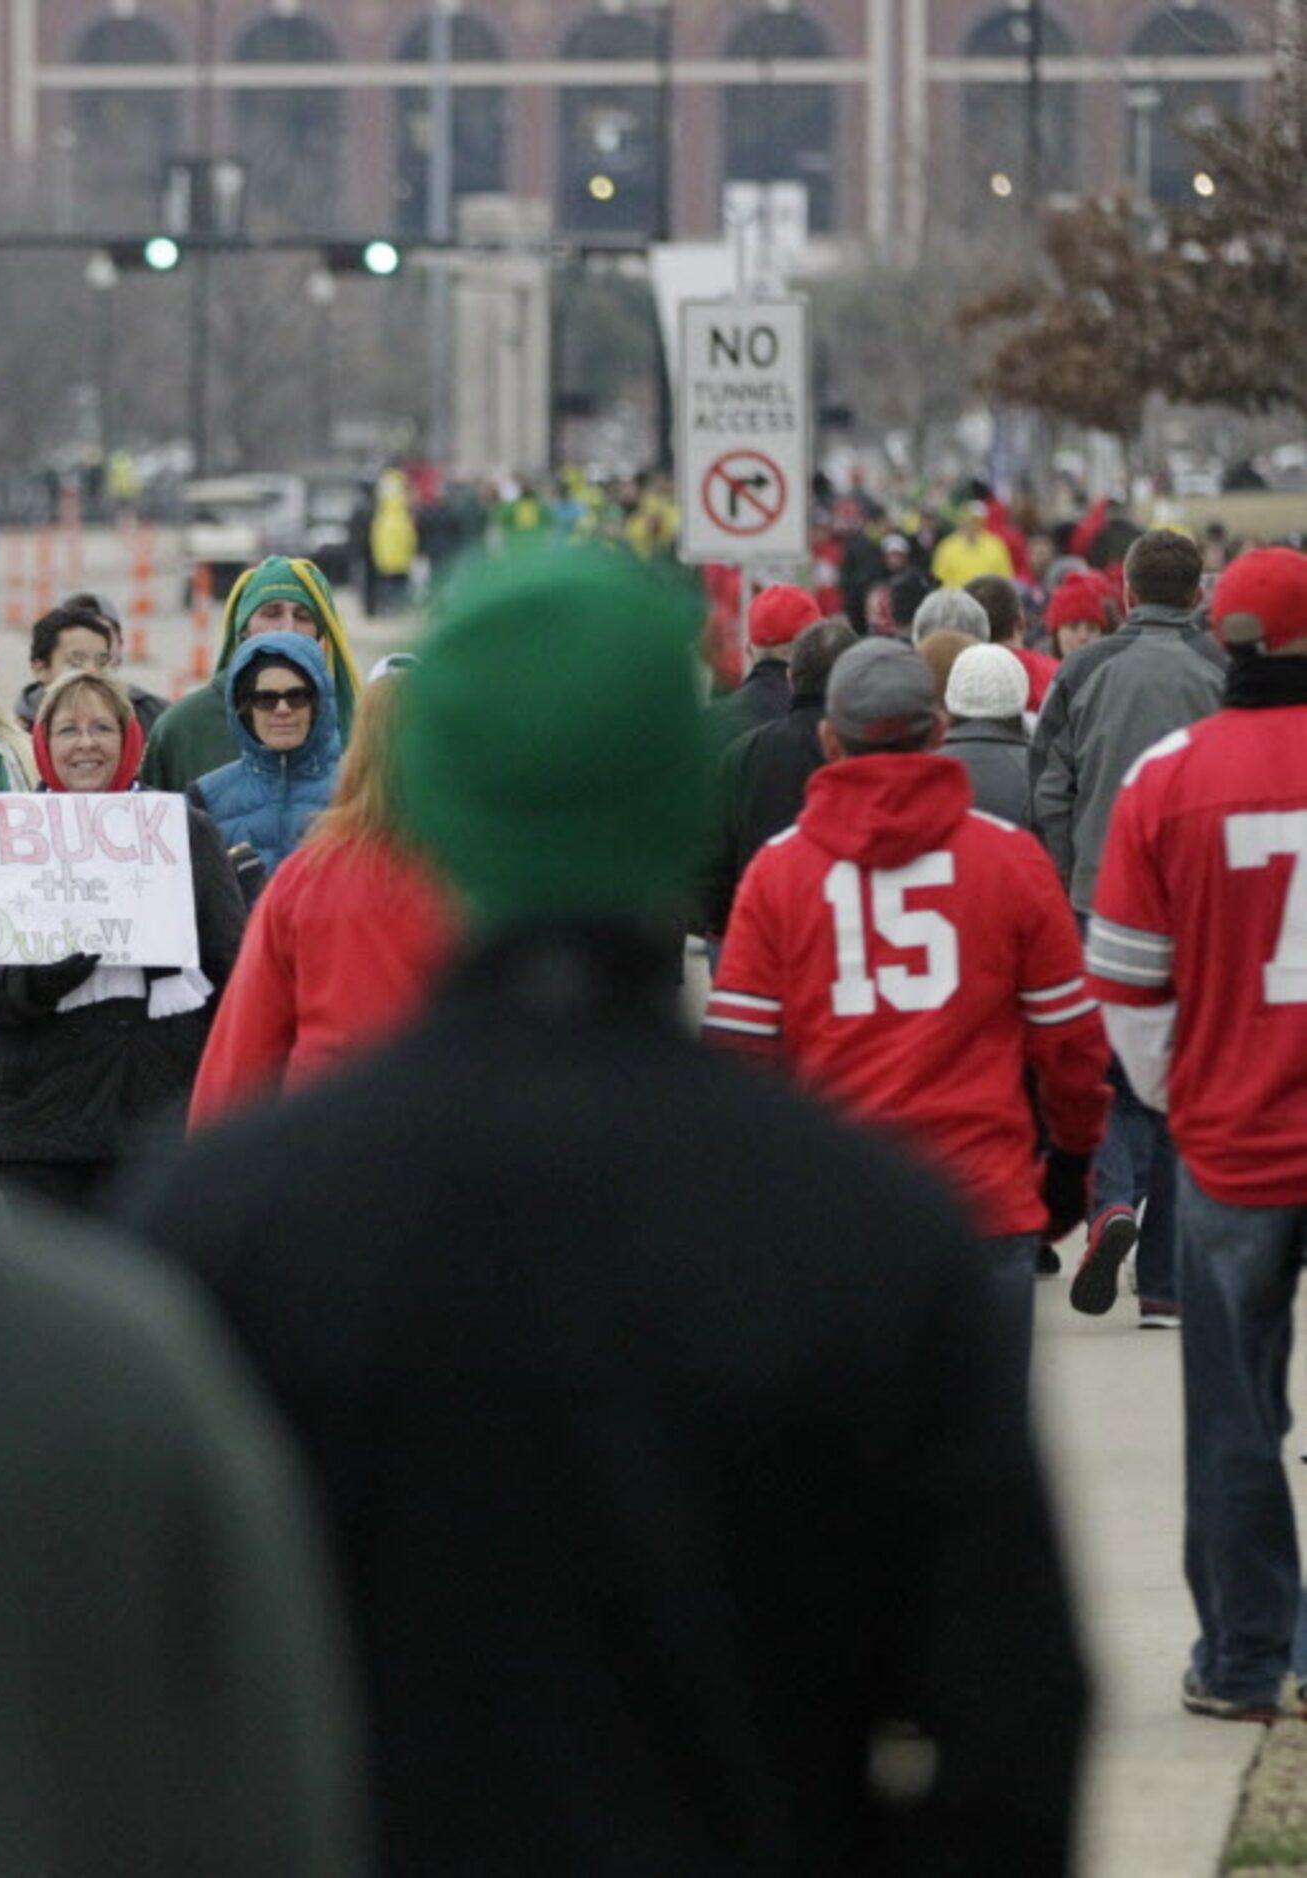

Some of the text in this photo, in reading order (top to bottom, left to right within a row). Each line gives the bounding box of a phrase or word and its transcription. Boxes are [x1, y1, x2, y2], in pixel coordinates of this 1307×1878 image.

[709, 325, 779, 368] NO
[695, 381, 793, 403] TUNNEL
[695, 409, 795, 432] ACCESS
[31, 861, 109, 903] the
[824, 851, 959, 1016] 15
